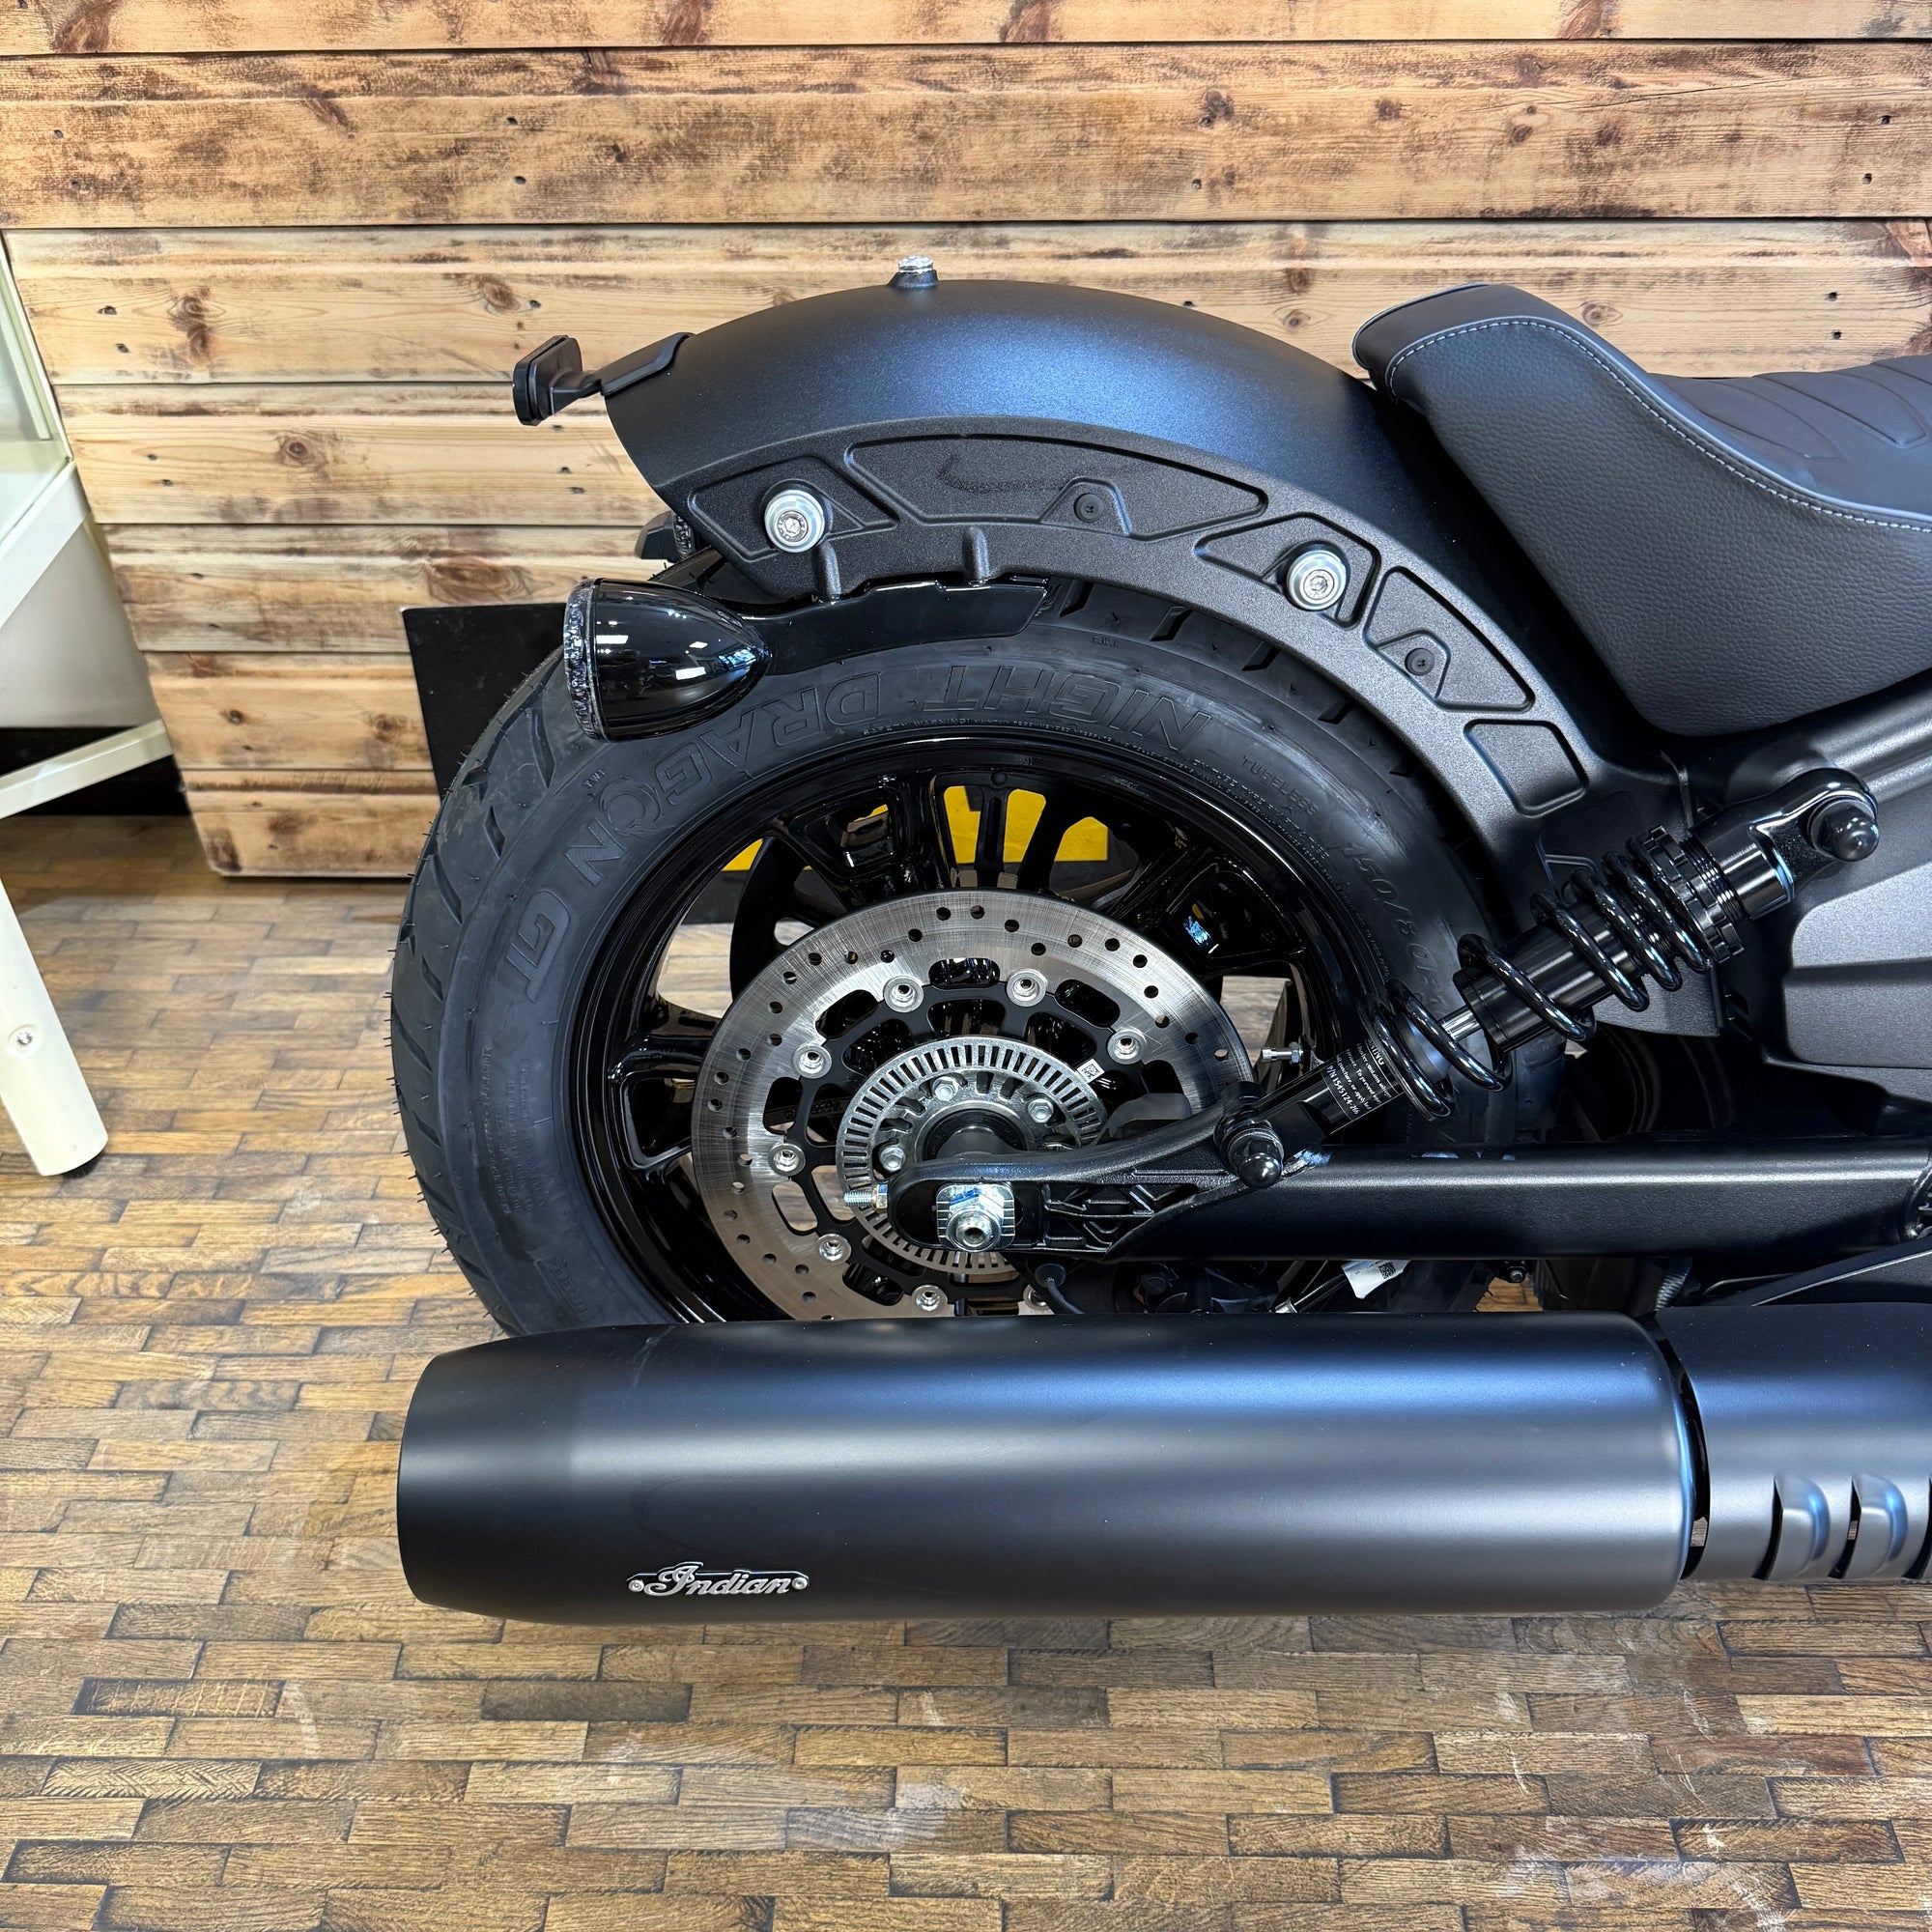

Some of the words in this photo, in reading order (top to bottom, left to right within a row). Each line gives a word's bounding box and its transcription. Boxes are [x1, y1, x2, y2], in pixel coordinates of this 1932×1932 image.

[922, 663, 1211, 752] NIGHT
[565, 671, 881, 887] DRAGON
[1241, 754, 1319, 815] TUBELESS
[497, 888, 572, 1004] GT
[1327, 1065, 1337, 1078] P/N
[644, 1563, 792, 1596] Indian
